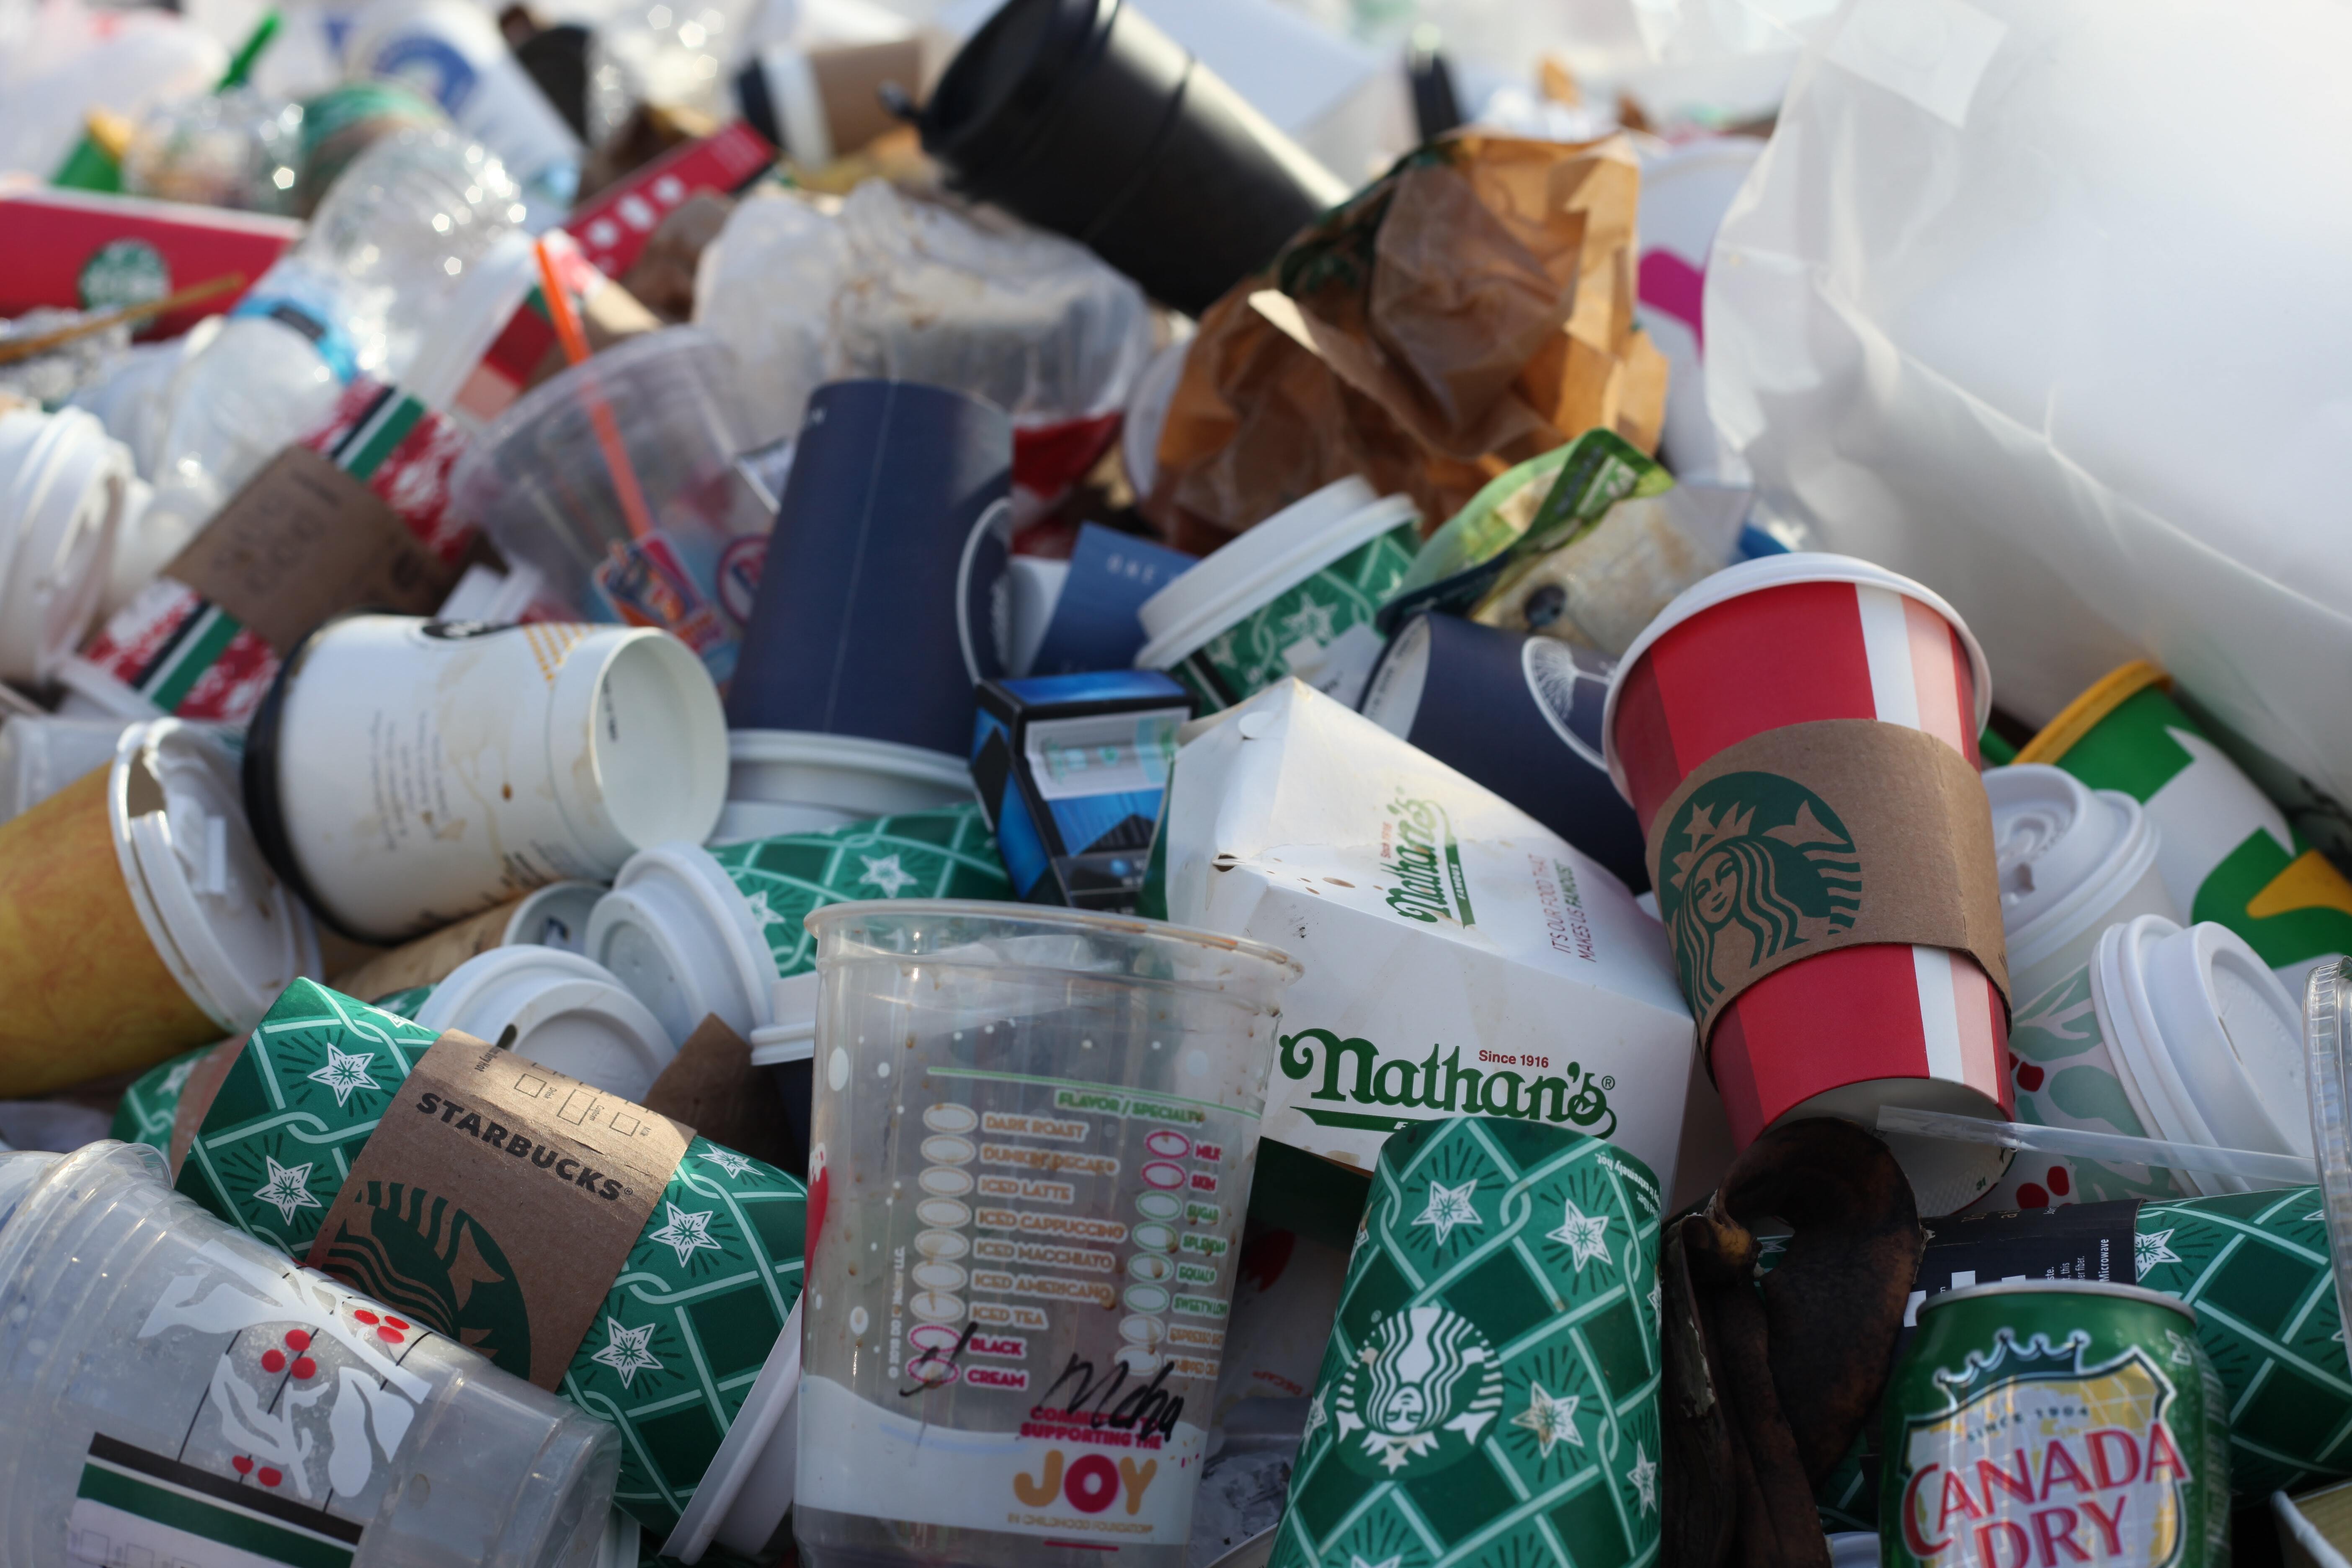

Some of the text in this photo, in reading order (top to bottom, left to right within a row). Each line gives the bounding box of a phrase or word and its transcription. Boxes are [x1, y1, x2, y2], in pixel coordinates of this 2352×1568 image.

[1449, 863, 1466, 900] FAMOUS
[1536, 879, 1560, 909] FOOD
[1544, 908, 1565, 931] OUR
[1567, 907, 1586, 923] US
[1571, 923, 1596, 963] MAKES
[474, 1060, 490, 1073] Hot
[1478, 1049, 1550, 1068] Since 1916
[544, 1087, 557, 1100] Drink
[588, 1104, 605, 1122] Custom
[1058, 1090, 1120, 1113] FLAVOR
[1132, 1101, 1205, 1124] SPECIALTY
[985, 1115, 1087, 1140] DARK ROAST
[1614, 1160, 1649, 1192] extremely
[982, 1178, 1071, 1201] ICED LATTE
[979, 1210, 1125, 1239] ICED CAPPUCCINO
[977, 1243, 1112, 1269] ICED MACCHIATO
[2061, 1262, 2070, 1274] this
[2075, 1256, 2085, 1273] fiber.
[2099, 1238, 2110, 1283] Microwave
[974, 1273, 1110, 1301] ICED AMERICANO
[972, 1306, 1044, 1326] ICED TEA
[970, 1336, 1022, 1357] BLACK
[966, 1369, 1026, 1388] CREAM
[1029, 1405, 1138, 1430] COMMIT
[1966, 1405, 2090, 1443] SINCE 1904
[1020, 1422, 1162, 1450] SUPPORTING THE
[1014, 1449, 1158, 1516] JOY
[1903, 1422, 2188, 1557] CANADA
[1022, 1513, 1090, 1530] CHILDHOOD
[1972, 1494, 2128, 1568] DRY
